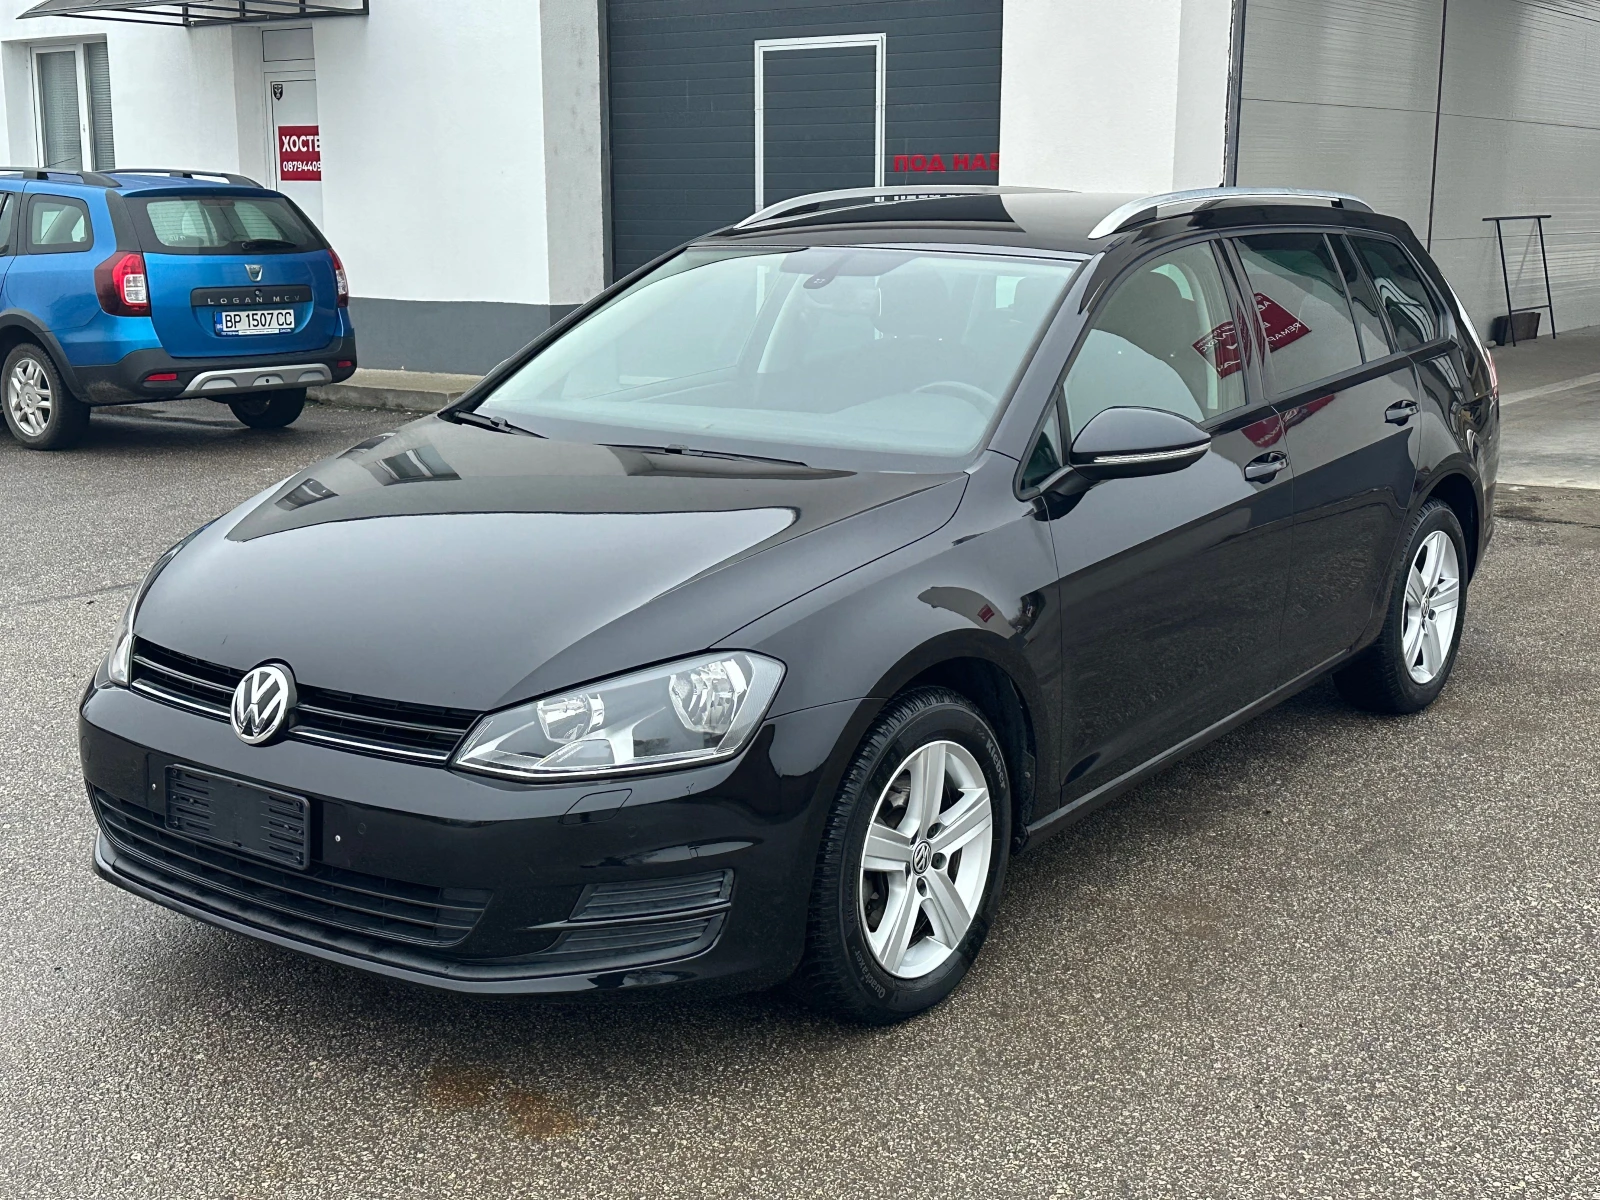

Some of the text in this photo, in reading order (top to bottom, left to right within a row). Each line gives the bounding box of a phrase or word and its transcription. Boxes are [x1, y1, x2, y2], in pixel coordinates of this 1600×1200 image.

[282, 135, 320, 152] ХОСТЕ
[893, 153, 946, 174] ПОД
[207, 296, 263, 305] LOGAN
[225, 311, 293, 329] BP 1507 CC
[985, 738, 1006, 789] Kleber
